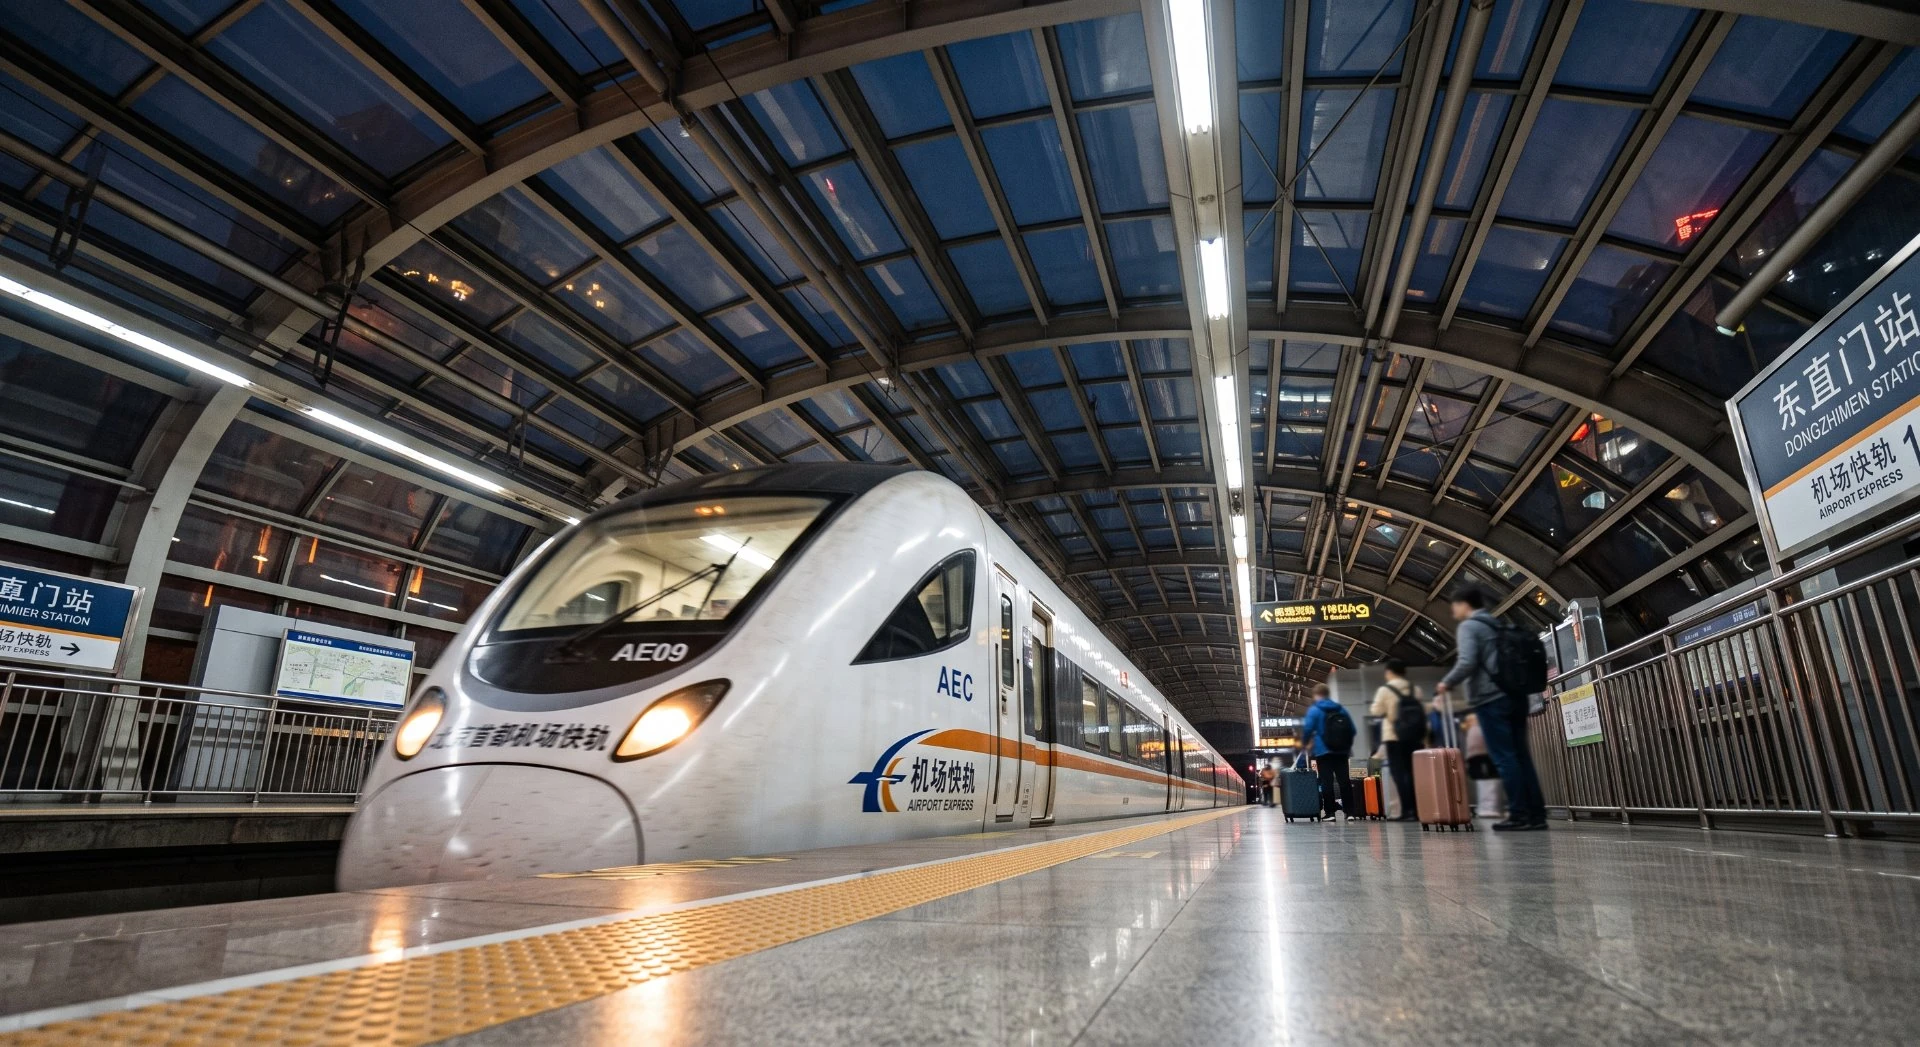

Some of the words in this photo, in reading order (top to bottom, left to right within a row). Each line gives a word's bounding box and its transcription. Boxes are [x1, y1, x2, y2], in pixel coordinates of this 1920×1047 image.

[1773, 292, 1920, 430] 东直门站
[1785, 388, 1871, 457] DONGZHIMEN
[1811, 437, 1897, 504] 机场快轨
[1820, 492, 1856, 519] AIRPORT
[1857, 468, 1903, 500] EXPRESS
[41, 610, 91, 626] STATION
[13, 647, 50, 657] EXPRESS
[609, 642, 689, 662] AE09
[937, 666, 973, 701] AEC
[910, 756, 975, 794] 机场快轨
[907, 799, 943, 811] AIRPORT
[943, 799, 974, 811] EXPRESS
